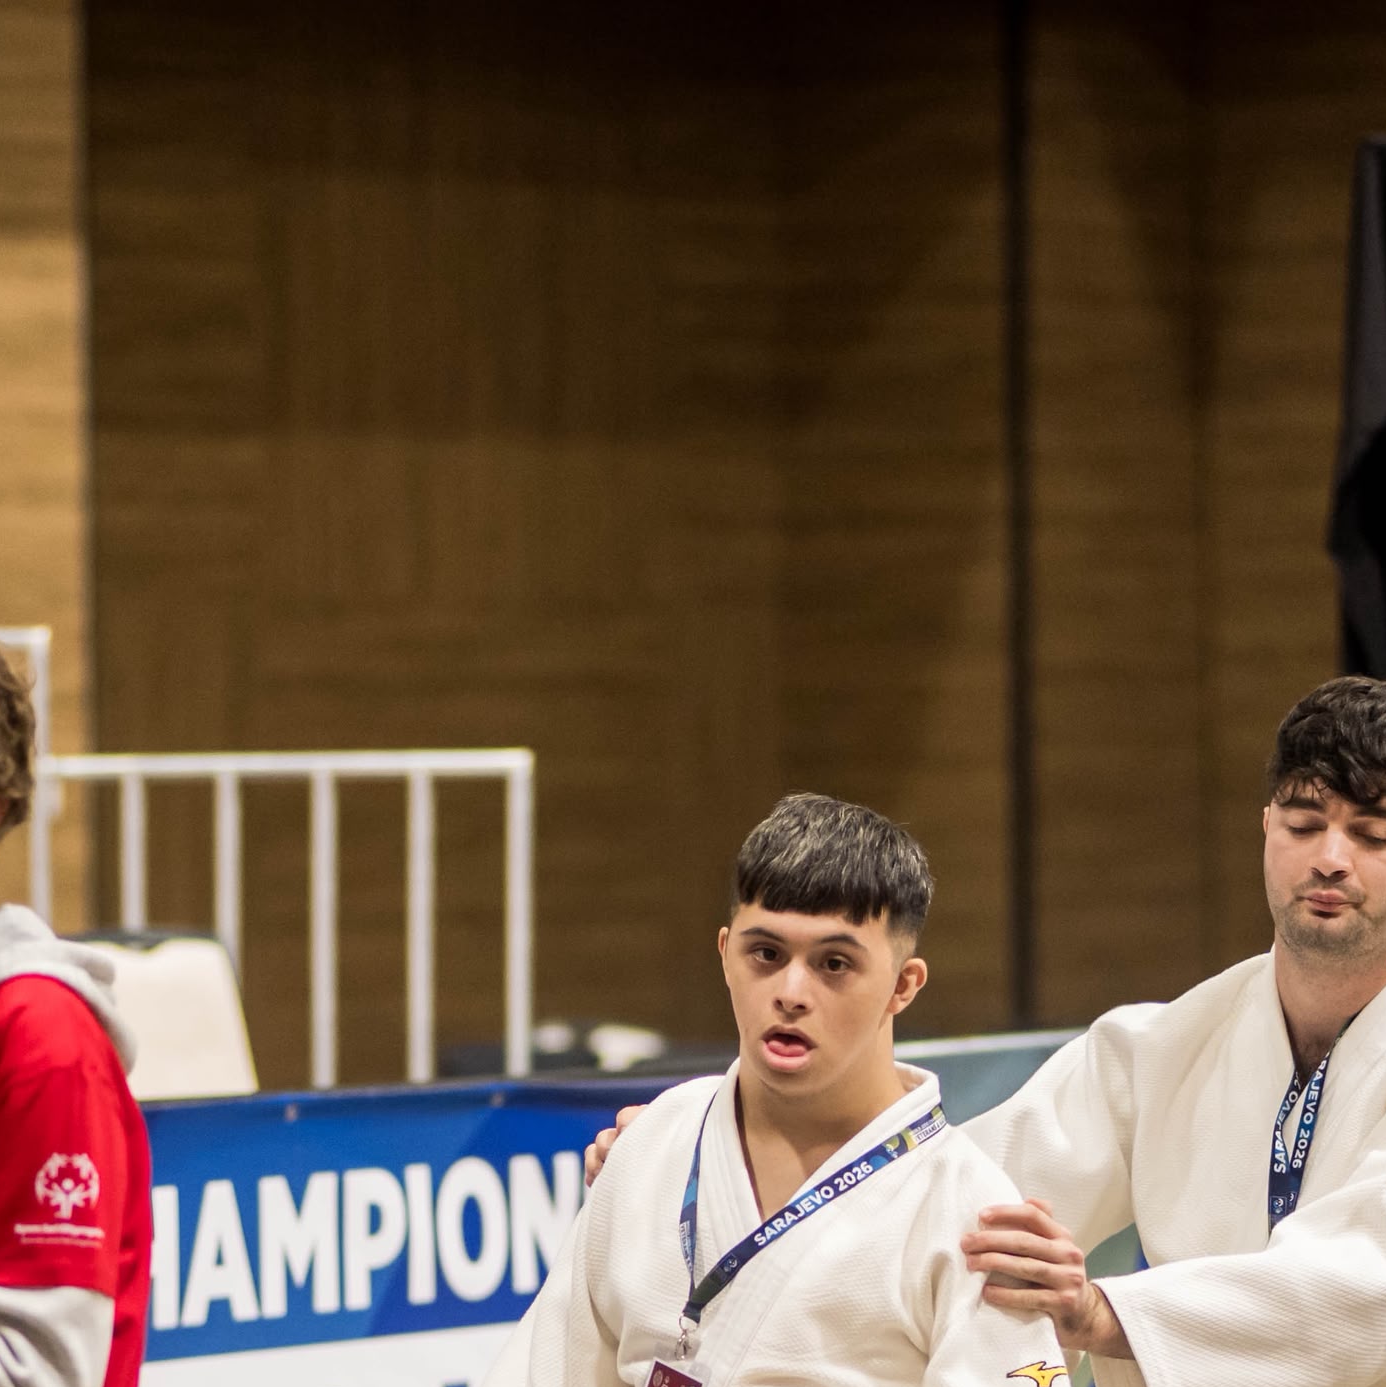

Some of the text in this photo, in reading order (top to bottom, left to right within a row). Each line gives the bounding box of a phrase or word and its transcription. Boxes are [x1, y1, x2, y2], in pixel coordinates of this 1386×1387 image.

[1273, 1091, 1300, 1174] SARAJEVO
[1292, 1051, 1330, 1168] RAJEVO 2026
[150, 1150, 583, 1331] AMPION
[754, 1160, 875, 1247] SARAJEVO 2026
